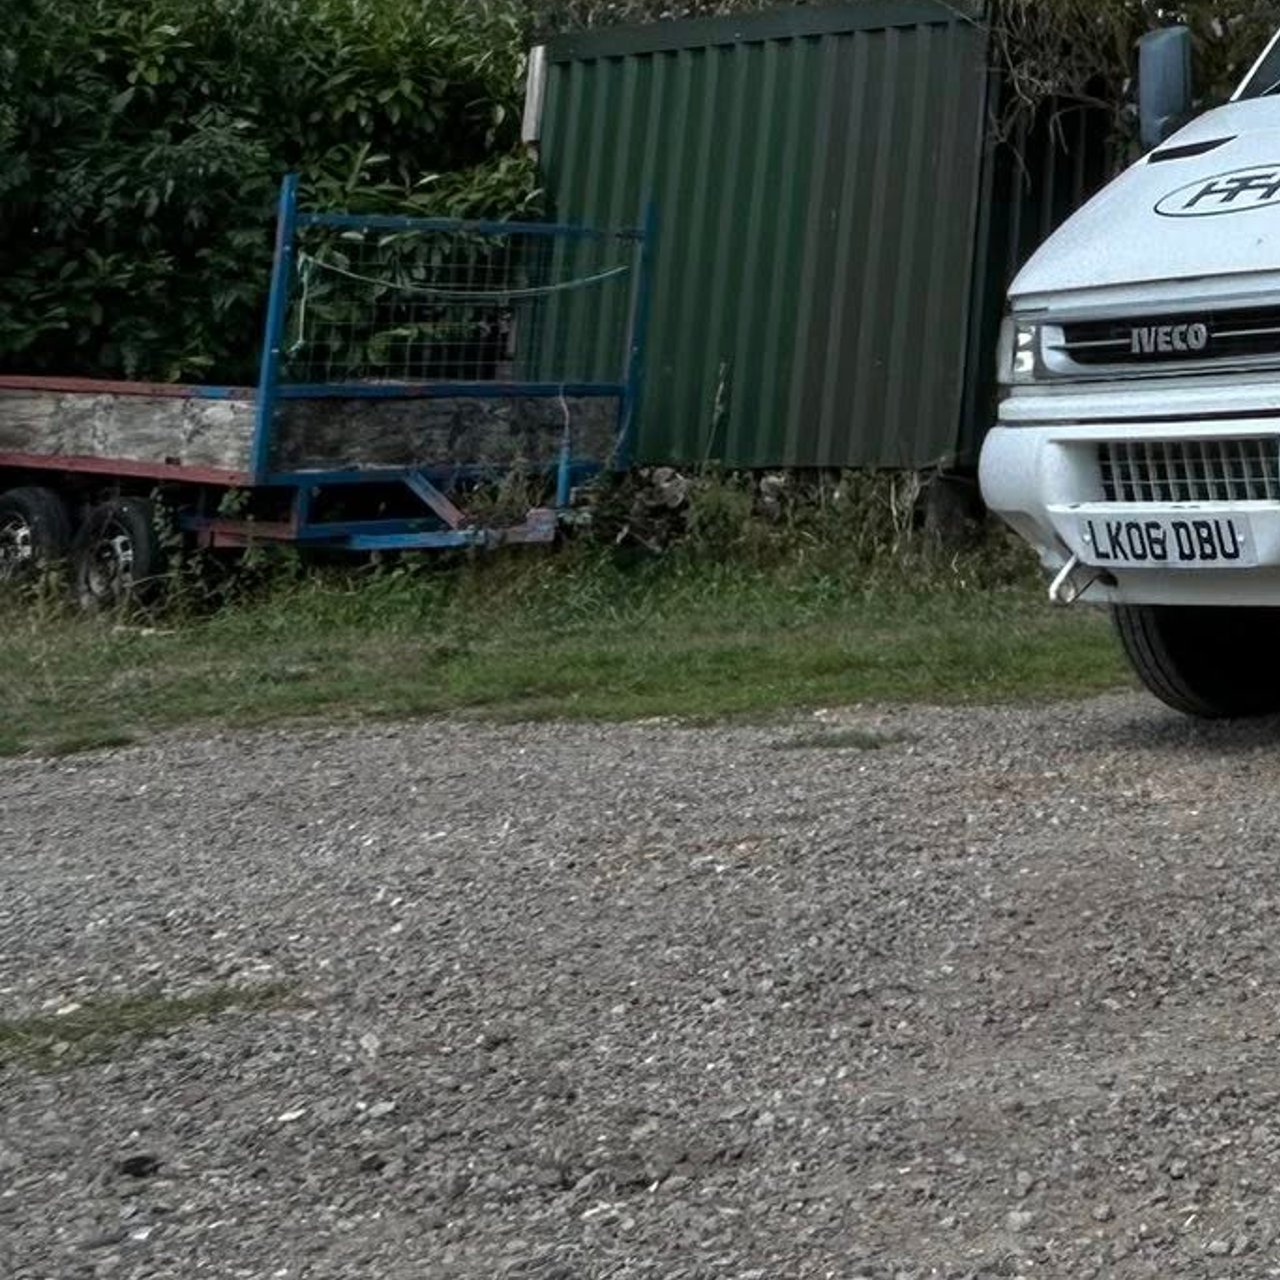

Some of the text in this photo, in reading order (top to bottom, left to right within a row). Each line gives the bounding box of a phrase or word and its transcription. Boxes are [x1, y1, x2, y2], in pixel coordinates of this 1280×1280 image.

[1131, 323, 1207, 353] IVECO
[1087, 519, 1240, 562] LK06 DBU
